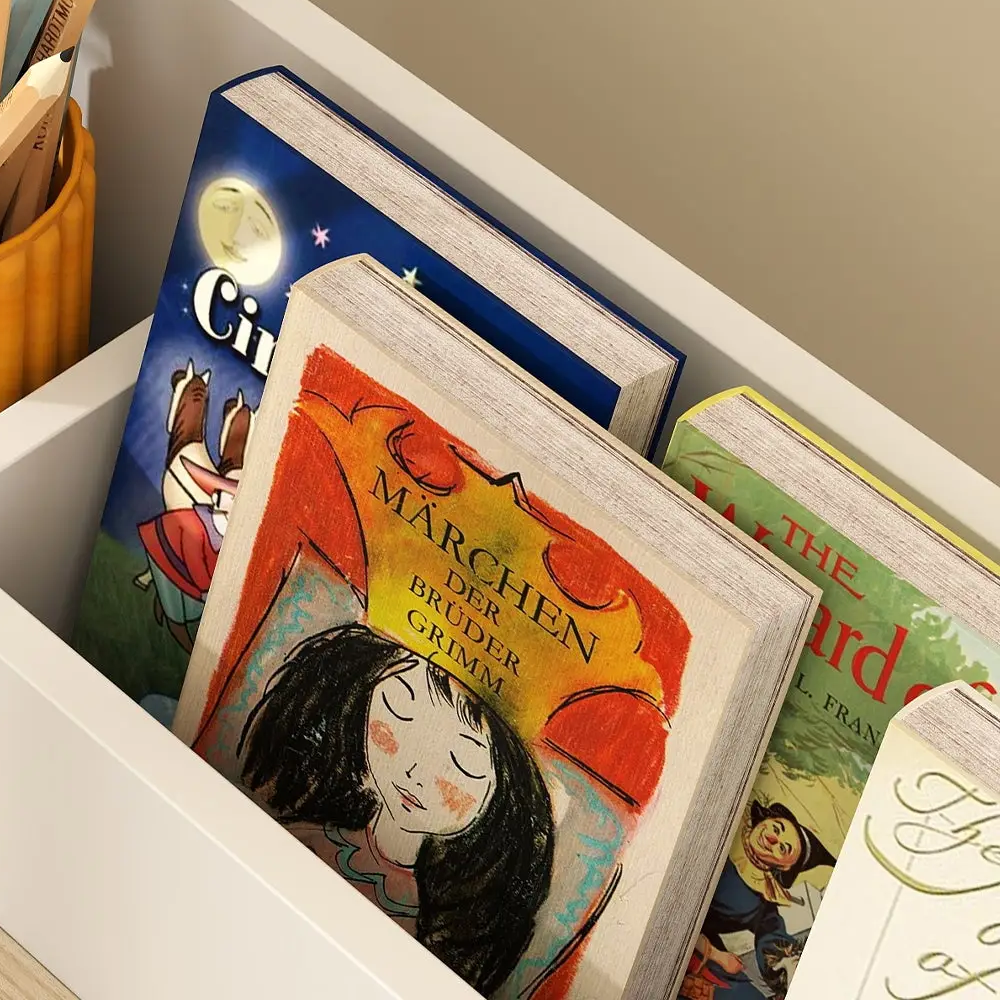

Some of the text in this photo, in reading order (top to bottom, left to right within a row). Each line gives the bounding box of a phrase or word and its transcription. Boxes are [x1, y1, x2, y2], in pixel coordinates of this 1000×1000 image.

[368, 466, 600, 664] MÄRCHEN
[444, 568, 501, 628] DER
[781, 514, 866, 600] THE
[407, 609, 507, 698] GRIMM
[408, 574, 521, 677] BRÜDER
